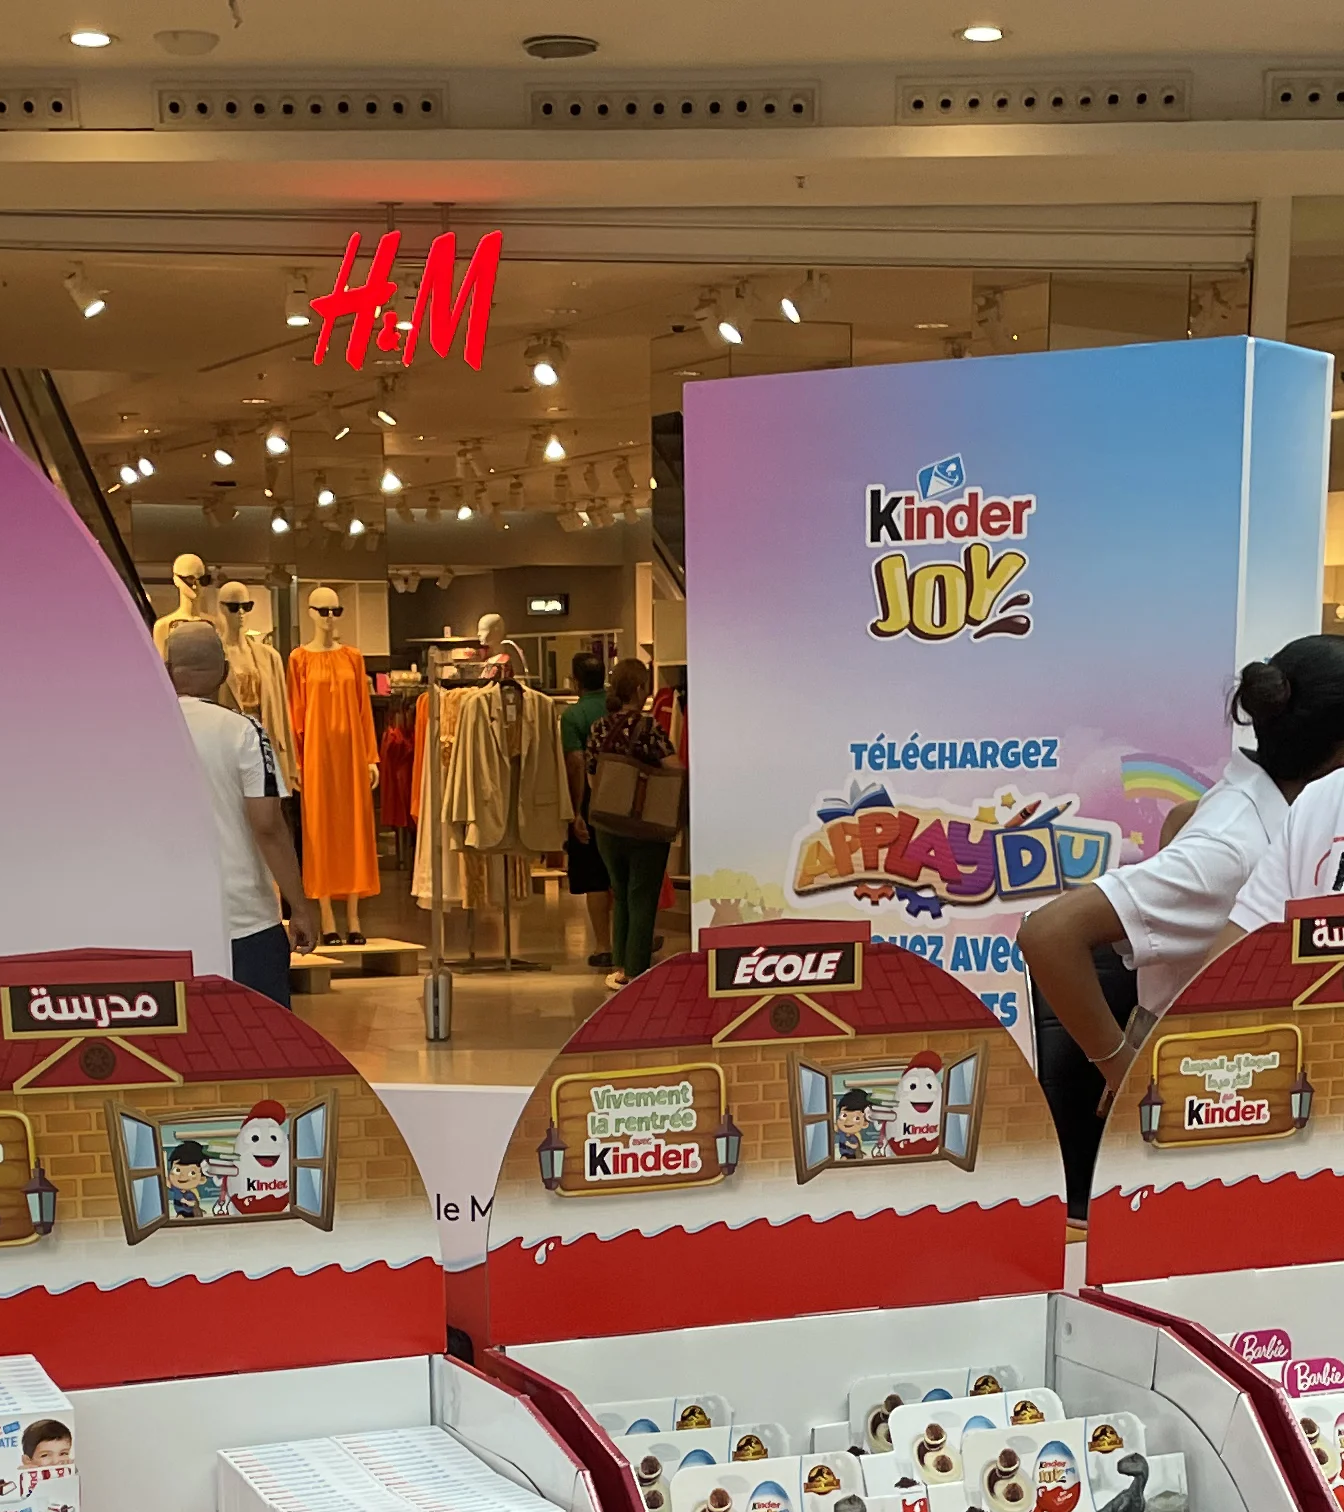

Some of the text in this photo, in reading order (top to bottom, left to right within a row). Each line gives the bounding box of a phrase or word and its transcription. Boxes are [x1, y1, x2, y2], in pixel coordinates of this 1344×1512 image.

[309, 229, 504, 371] H&M
[869, 489, 1033, 543] Kinder
[869, 543, 1030, 640] JOY
[850, 732, 1058, 770] TÉLÉCHARGEZ
[798, 810, 1103, 896] APPLAYDU
[733, 946, 844, 985] ÉCOLE
[28, 984, 159, 1027] مدرسة
[594, 1084, 690, 1109] Vivement
[1188, 1100, 1265, 1126] Kinder
[590, 1108, 694, 1134] la rentrée
[902, 1121, 939, 1137] Kinder
[589, 1143, 695, 1176] Kinder
[247, 1178, 288, 1191] Kinder
[436, 1194, 460, 1221] le
[1242, 1335, 1288, 1360] Barbie
